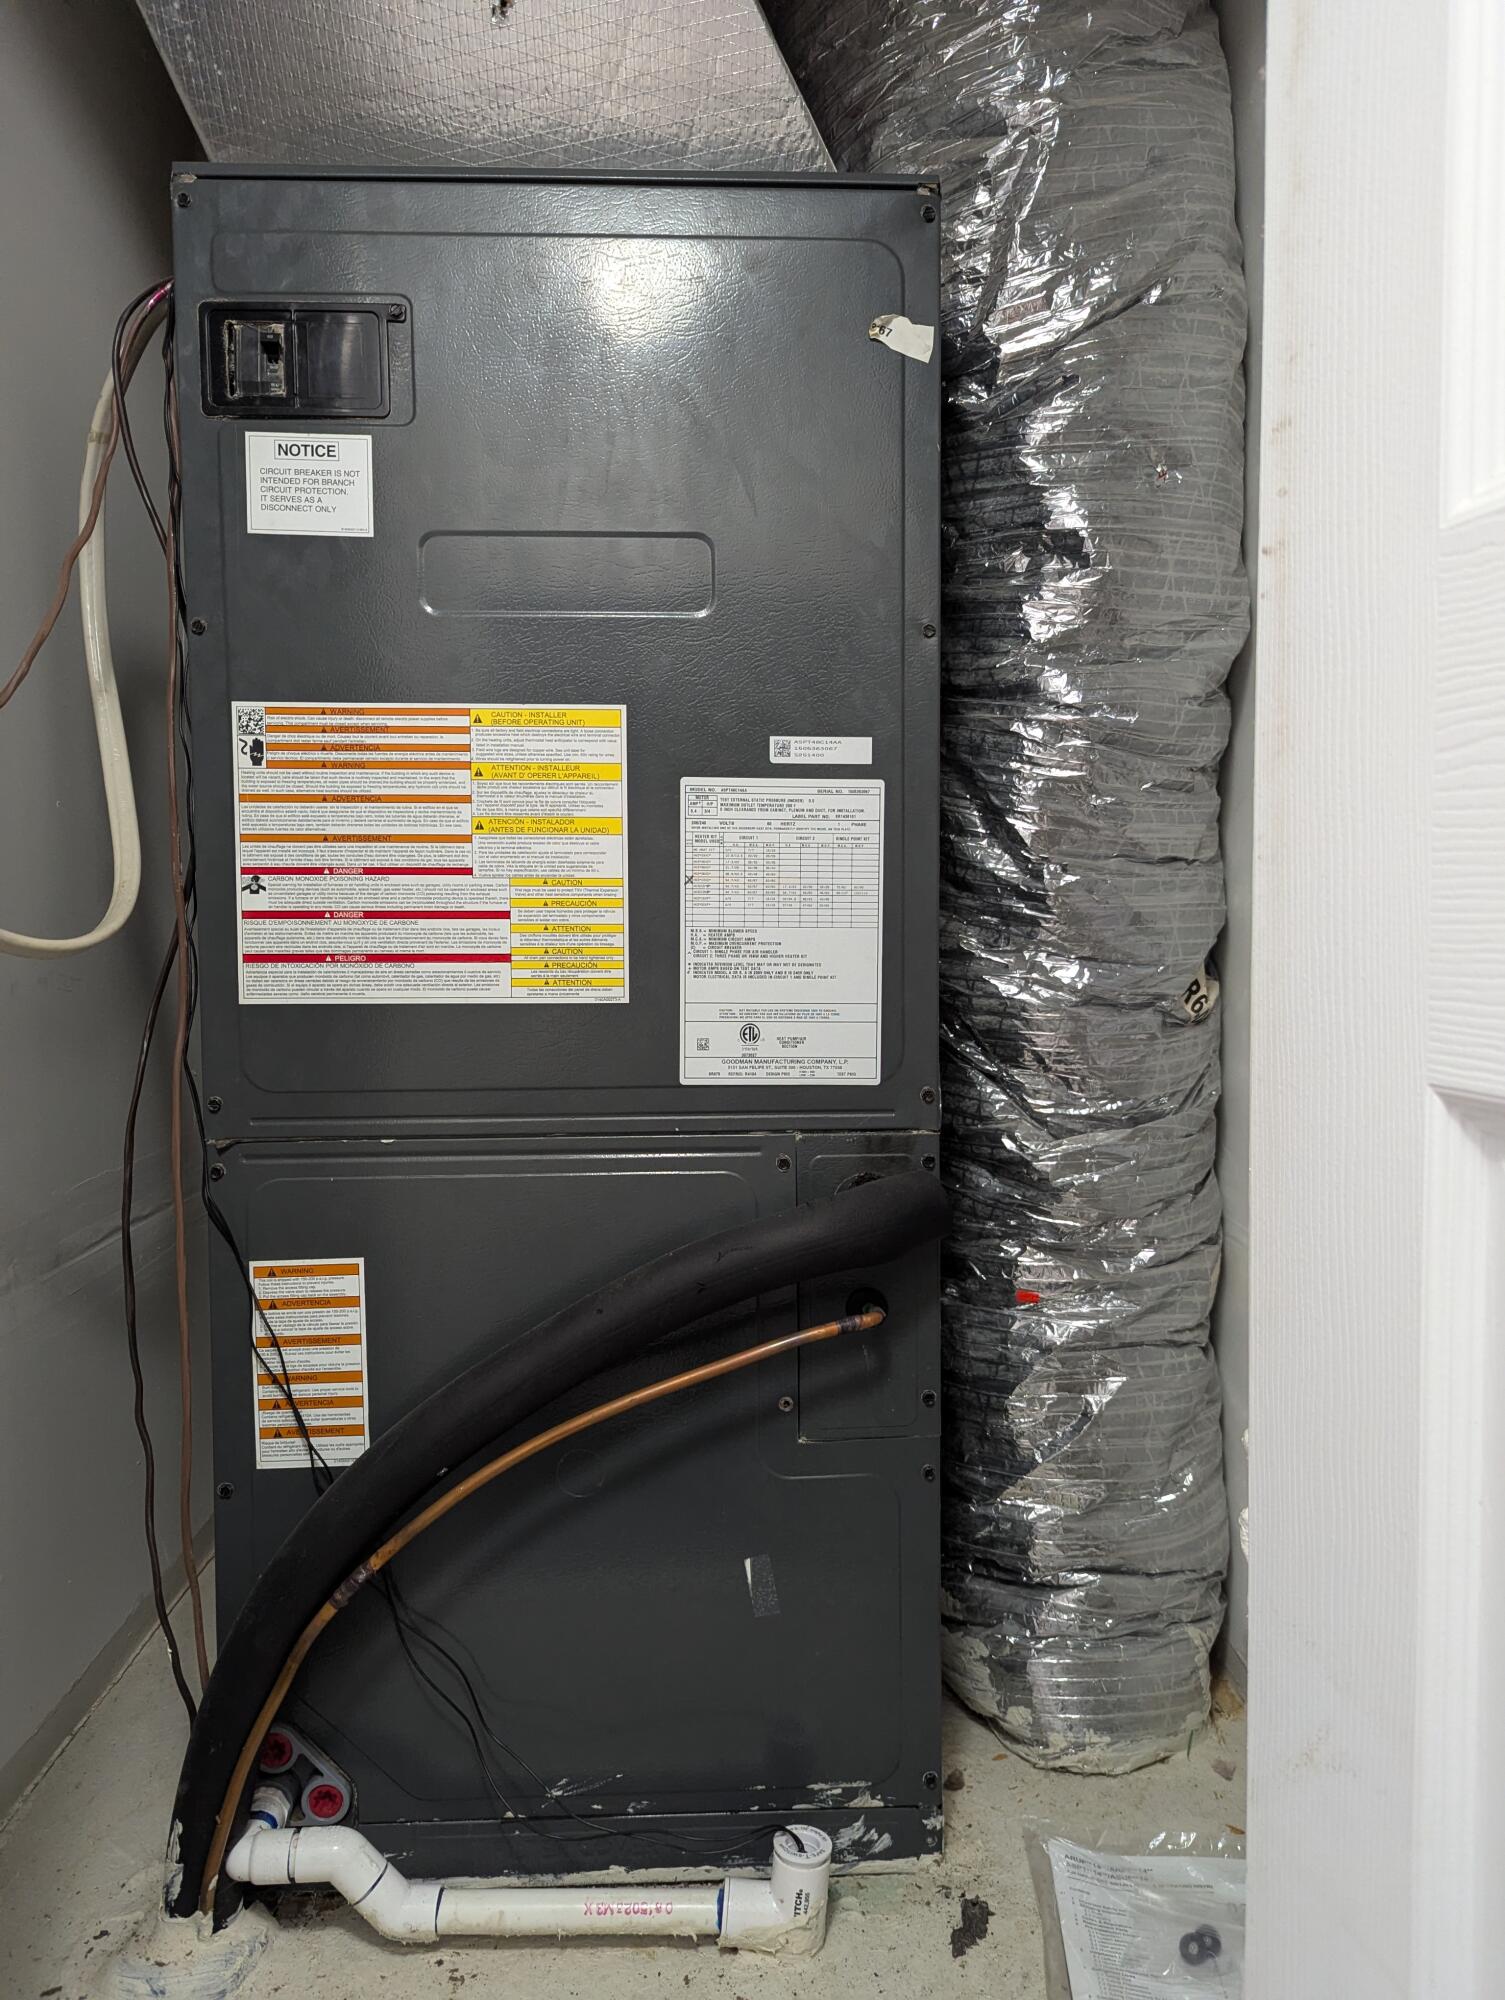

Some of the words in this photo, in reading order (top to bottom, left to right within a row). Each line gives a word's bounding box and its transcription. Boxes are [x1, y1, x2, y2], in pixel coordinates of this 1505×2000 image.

[277, 443, 337, 458] NOTICE
[260, 467, 292, 476] CIRCUIT
[294, 468, 332, 477] BREAKER
[334, 469, 342, 477] IS
[260, 477, 300, 485] INTENDED
[321, 478, 355, 486] BRANCH
[270, 495, 302, 503] SERVES
[261, 504, 312, 512] DISCONNECT
[315, 505, 337, 513] ONLY
[332, 834, 391, 842] AVERTISSEMENT
